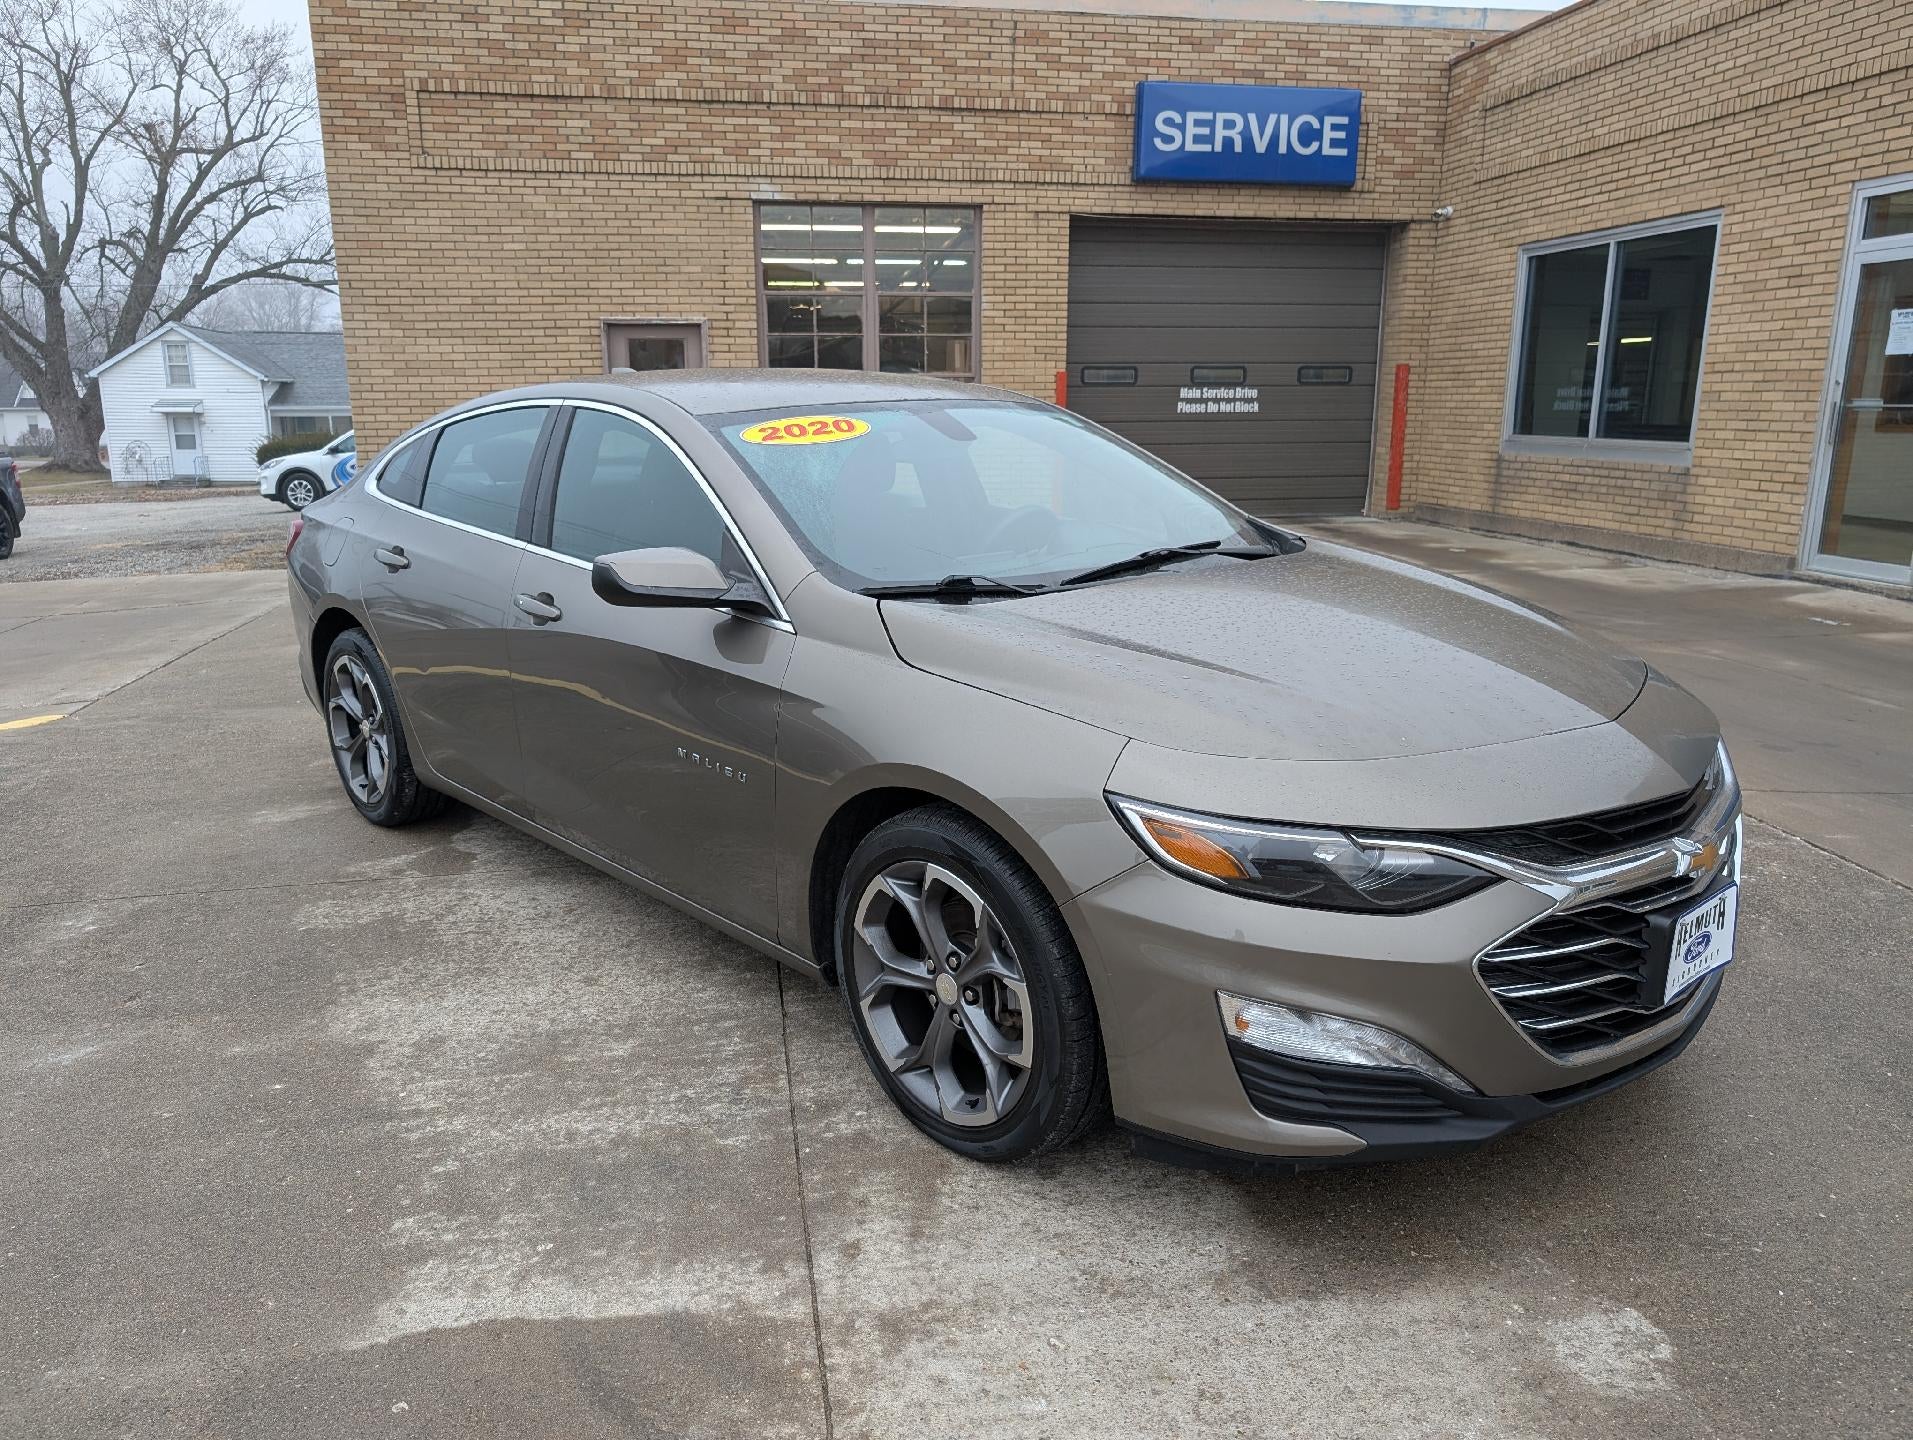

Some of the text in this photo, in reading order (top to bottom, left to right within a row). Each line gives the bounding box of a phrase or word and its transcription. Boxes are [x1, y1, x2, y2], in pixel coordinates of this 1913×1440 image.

[1153, 110, 1349, 157] SERVICE
[1180, 387, 1258, 399] Main Service Drive
[1177, 401, 1259, 413] Please Do Not Block
[758, 419, 856, 442] 2020
[677, 747, 747, 784] MALIBU
[1674, 896, 1727, 960] HELMUTH
[1686, 935, 1710, 961] Ford
